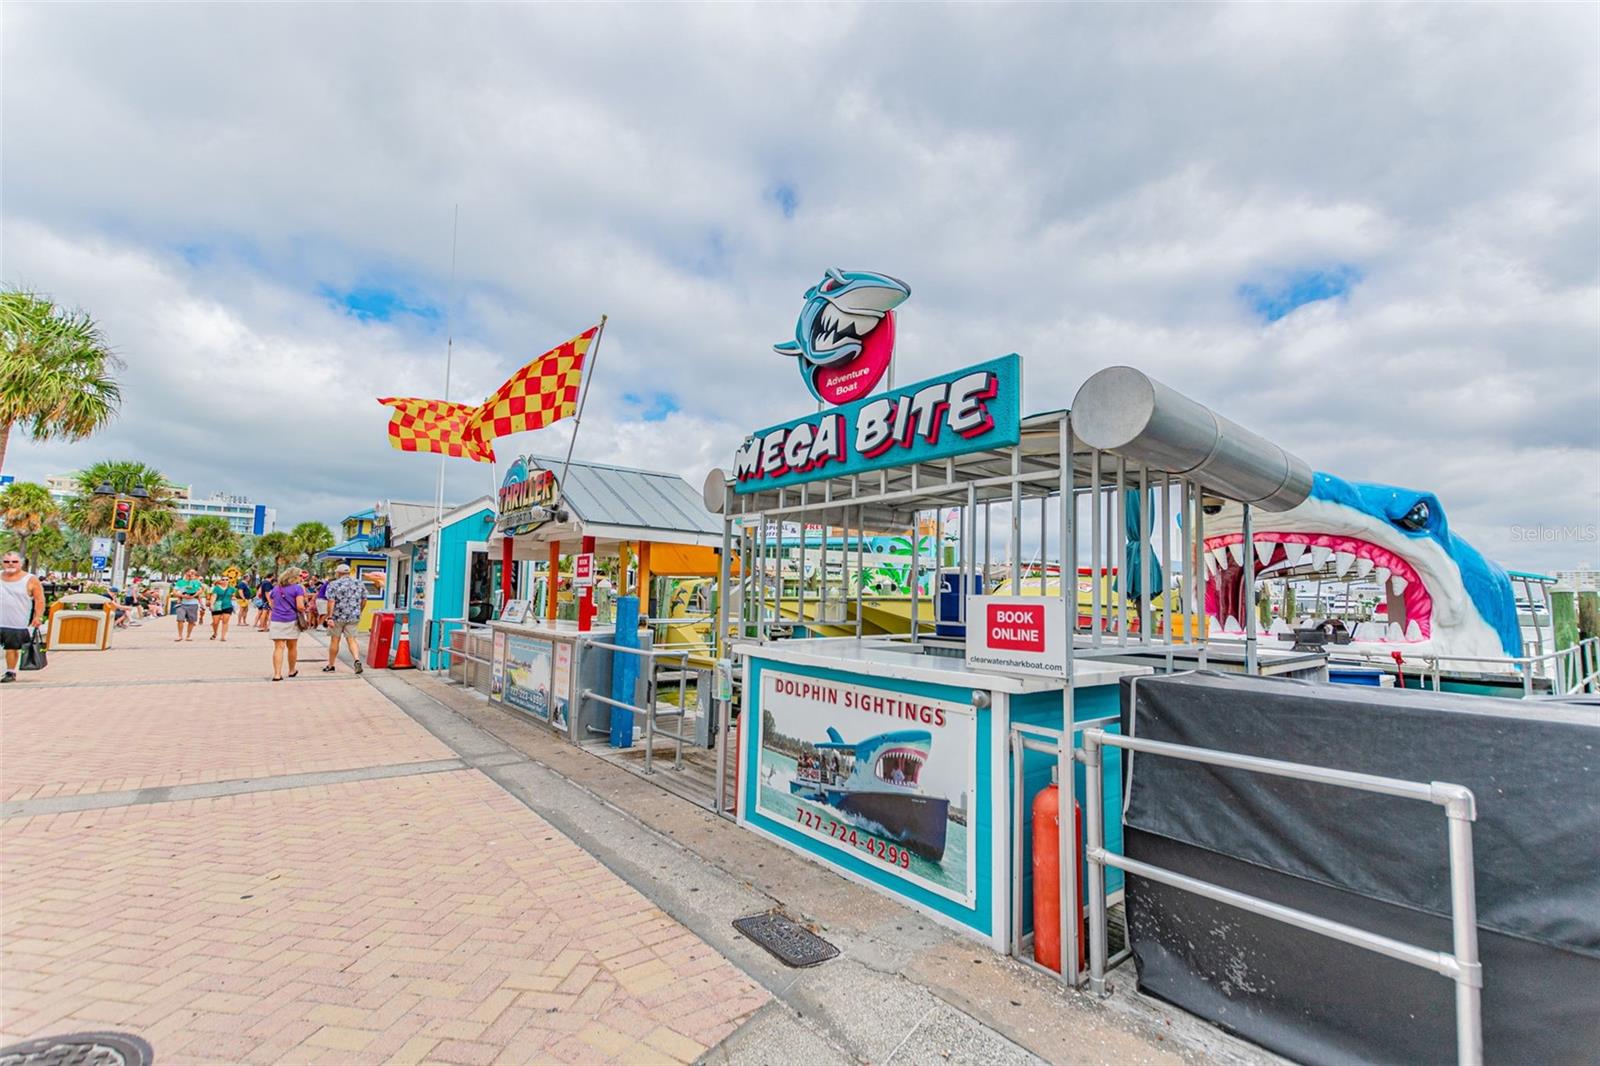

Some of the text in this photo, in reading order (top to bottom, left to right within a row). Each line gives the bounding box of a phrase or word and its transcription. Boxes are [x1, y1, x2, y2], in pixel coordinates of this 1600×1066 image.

[825, 367, 870, 387] Adventure
[835, 382, 858, 396] Boat
[733, 371, 998, 482] MEGA BITE
[499, 470, 553, 513] THRILLER
[997, 611, 1033, 624] BOOK
[992, 627, 1039, 642] ONLINE
[970, 656, 1063, 671] clearwatersharkboat.com
[775, 678, 946, 726] DOLPHIN SIGHTINGS
[796, 807, 910, 869] 727-724-4299
